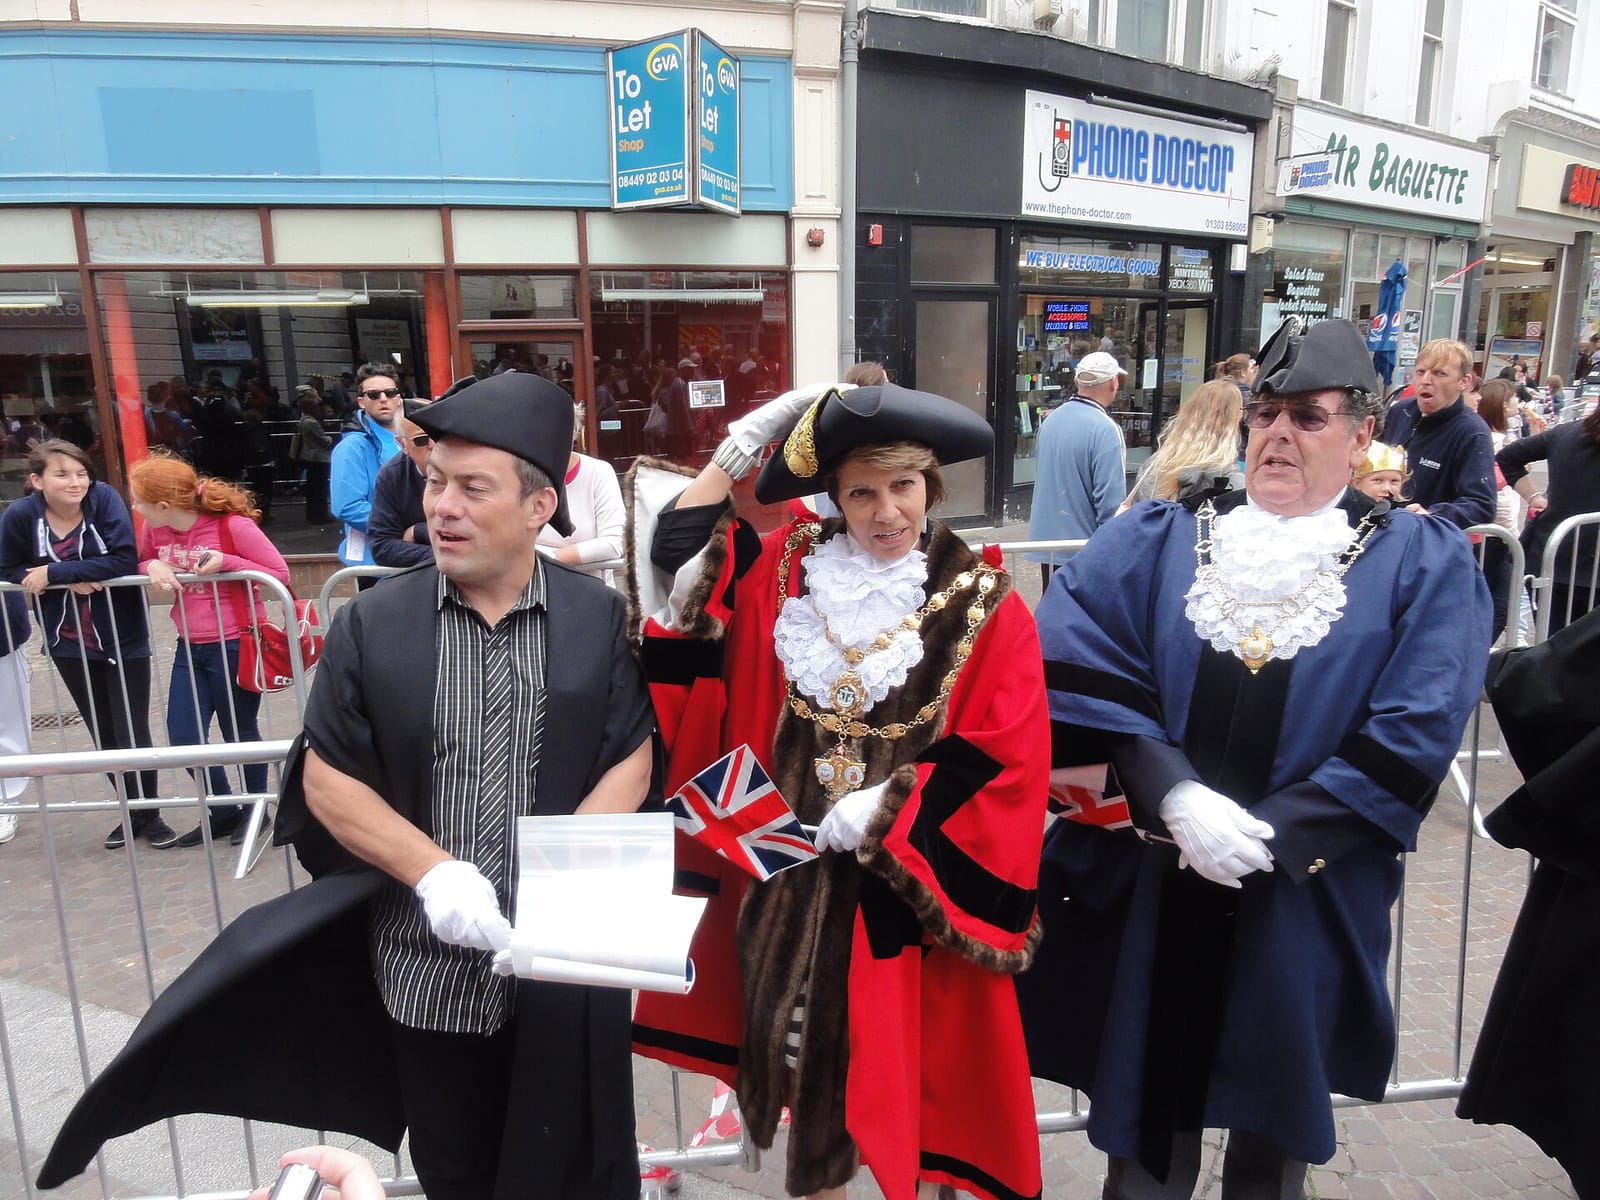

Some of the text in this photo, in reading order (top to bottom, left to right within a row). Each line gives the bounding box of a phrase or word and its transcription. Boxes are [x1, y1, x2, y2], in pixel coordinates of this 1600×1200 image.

[652, 53, 679, 74] GVA
[615, 70, 642, 100] To
[701, 61, 715, 98] To
[720, 68, 736, 90] GVA
[618, 100, 652, 134] Let
[701, 97, 719, 135] Let
[618, 139, 645, 153] Shop
[618, 168, 684, 188] 08449 02 03 04
[654, 183, 682, 196] gva.co.uk
[1025, 201, 1132, 221] www.thephone-doctor.com
[1205, 218, 1247, 233] 01303 858005
[1026, 250, 1160, 276] WE BUY ELECTRICAL GOODS
[1174, 268, 1209, 279] NINTENDO
[1284, 267, 1306, 280] Salad
[1198, 279, 1214, 292] Wii
[1286, 282, 1321, 300] Baguettes
